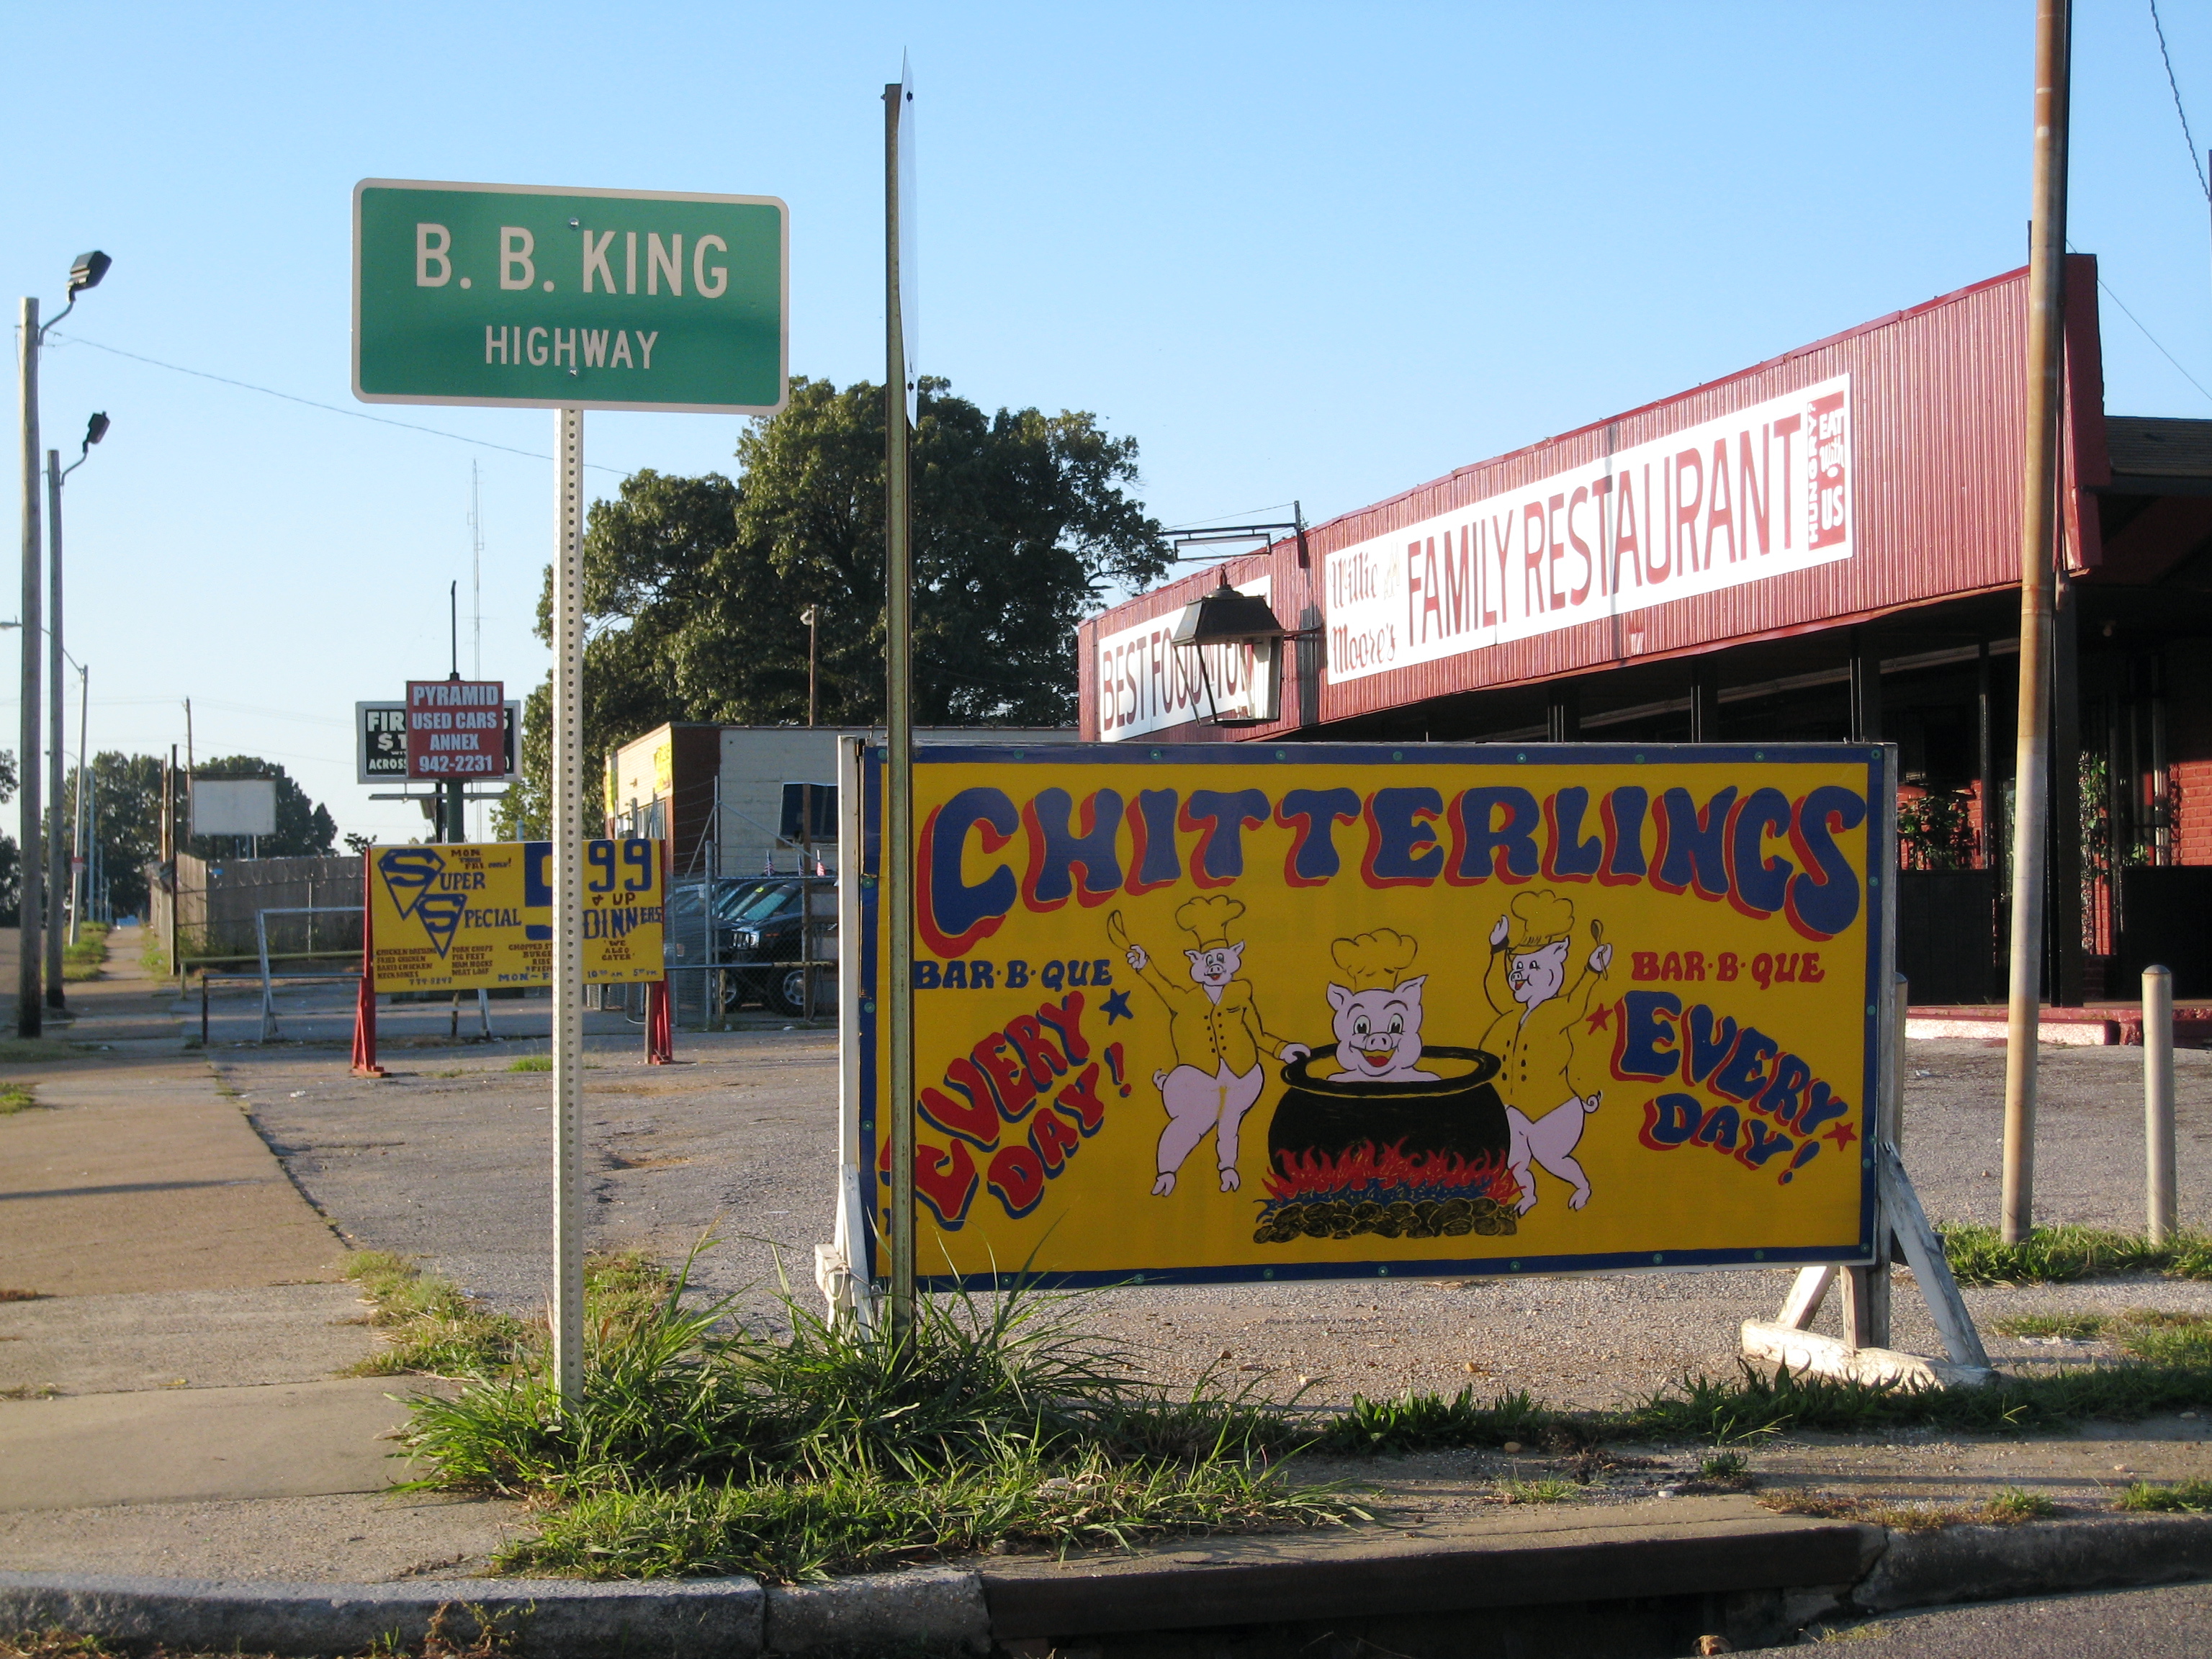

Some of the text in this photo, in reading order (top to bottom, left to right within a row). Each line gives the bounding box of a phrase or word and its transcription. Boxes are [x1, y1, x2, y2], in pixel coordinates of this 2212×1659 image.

[416, 223, 728, 299] B. B. KING
[485, 325, 658, 369] HIGHWAY
[1819, 408, 1844, 440] EAT
[1408, 413, 1800, 647] FAMILY RESTAURANT
[1821, 485, 1843, 530] US
[1329, 552, 1377, 609] Willie
[1330, 623, 1396, 674] Moore's
[413, 685, 498, 706] PYRAMID
[1102, 637, 1146, 731] BEST
[1151, 627, 1203, 717] FOOD
[412, 713, 451, 729] USED
[456, 711, 497, 729] CARS
[430, 733, 479, 750] ANNEX
[419, 755, 493, 772] 942-2231
[917, 786, 1867, 958] CHITTERLINGS
[612, 892, 637, 907] UP
[1609, 991, 1848, 1138] EVERY
[879, 991, 1090, 1231] EVERY
